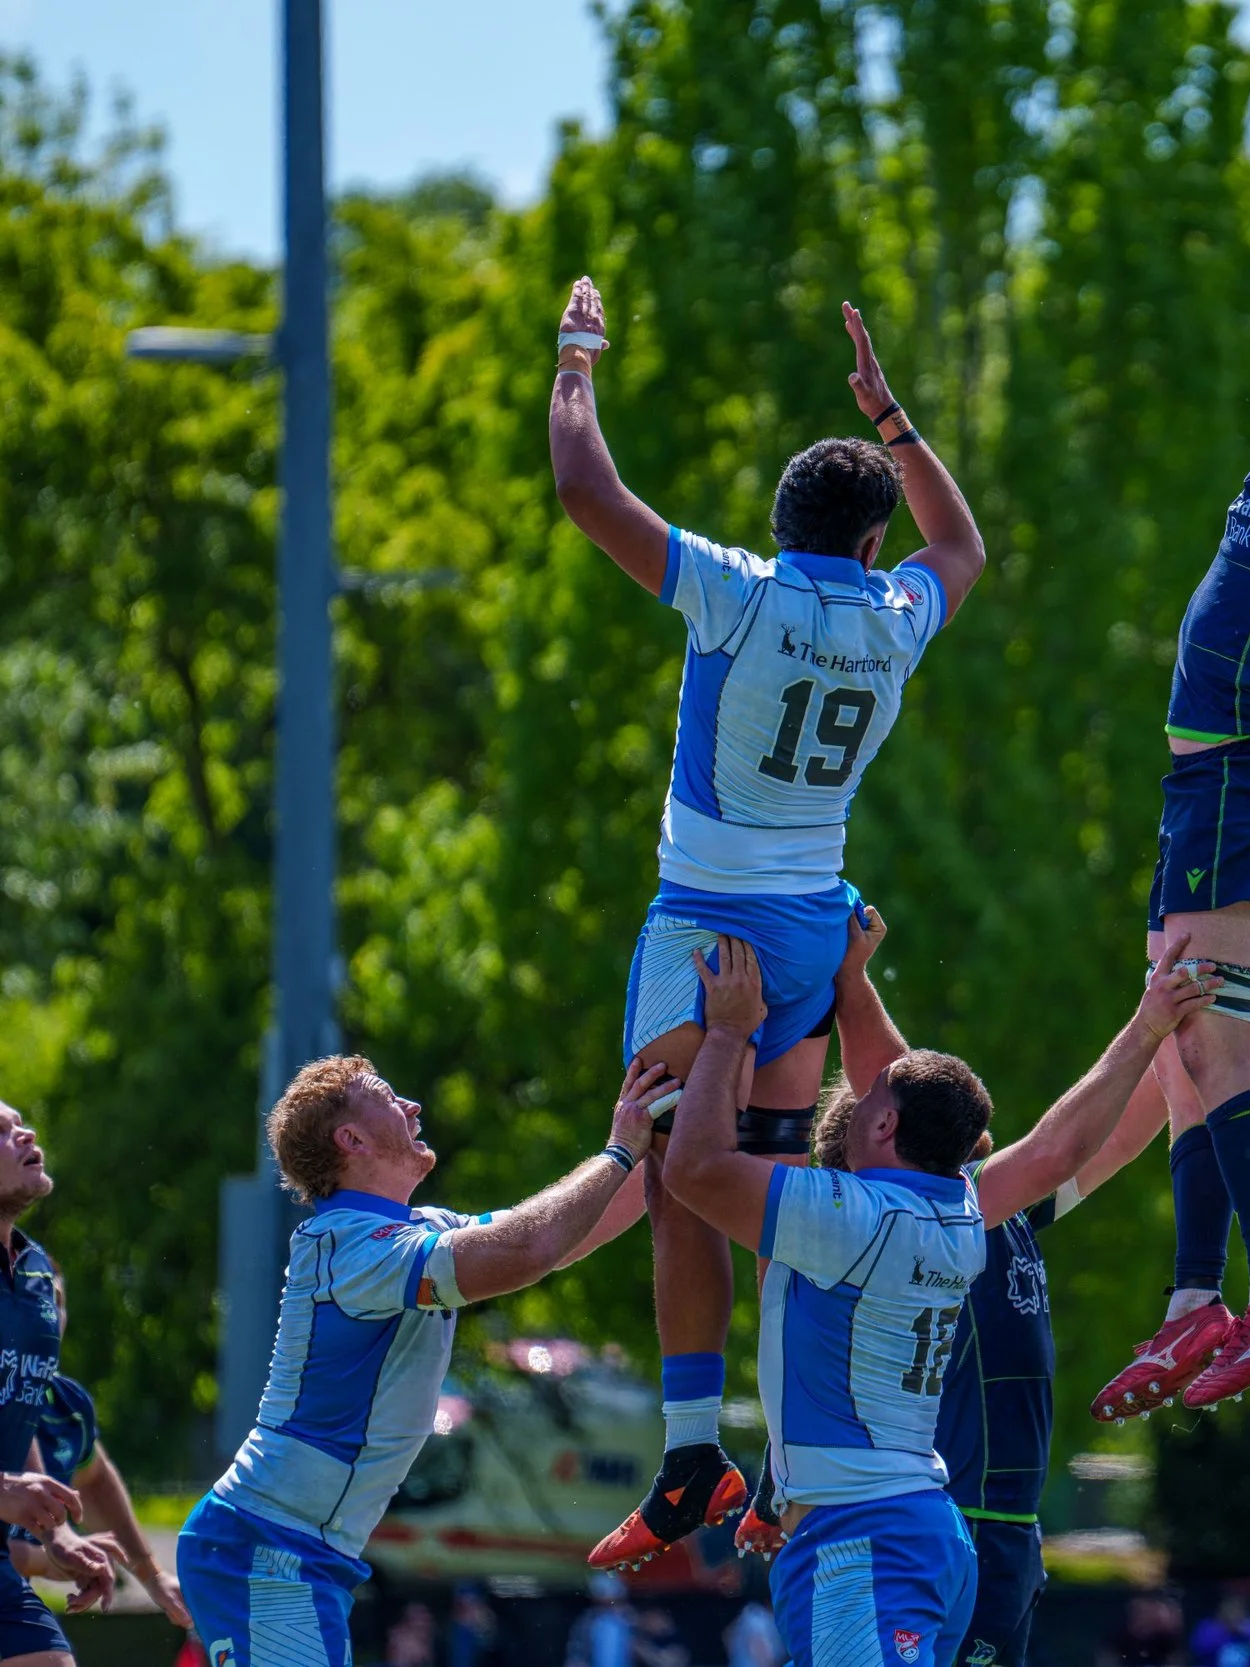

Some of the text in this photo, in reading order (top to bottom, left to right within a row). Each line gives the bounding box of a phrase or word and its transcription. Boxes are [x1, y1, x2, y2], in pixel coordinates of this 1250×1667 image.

[800, 642, 893, 673] The Hartford
[757, 678, 878, 788] 19
[925, 1270, 950, 1288] The
